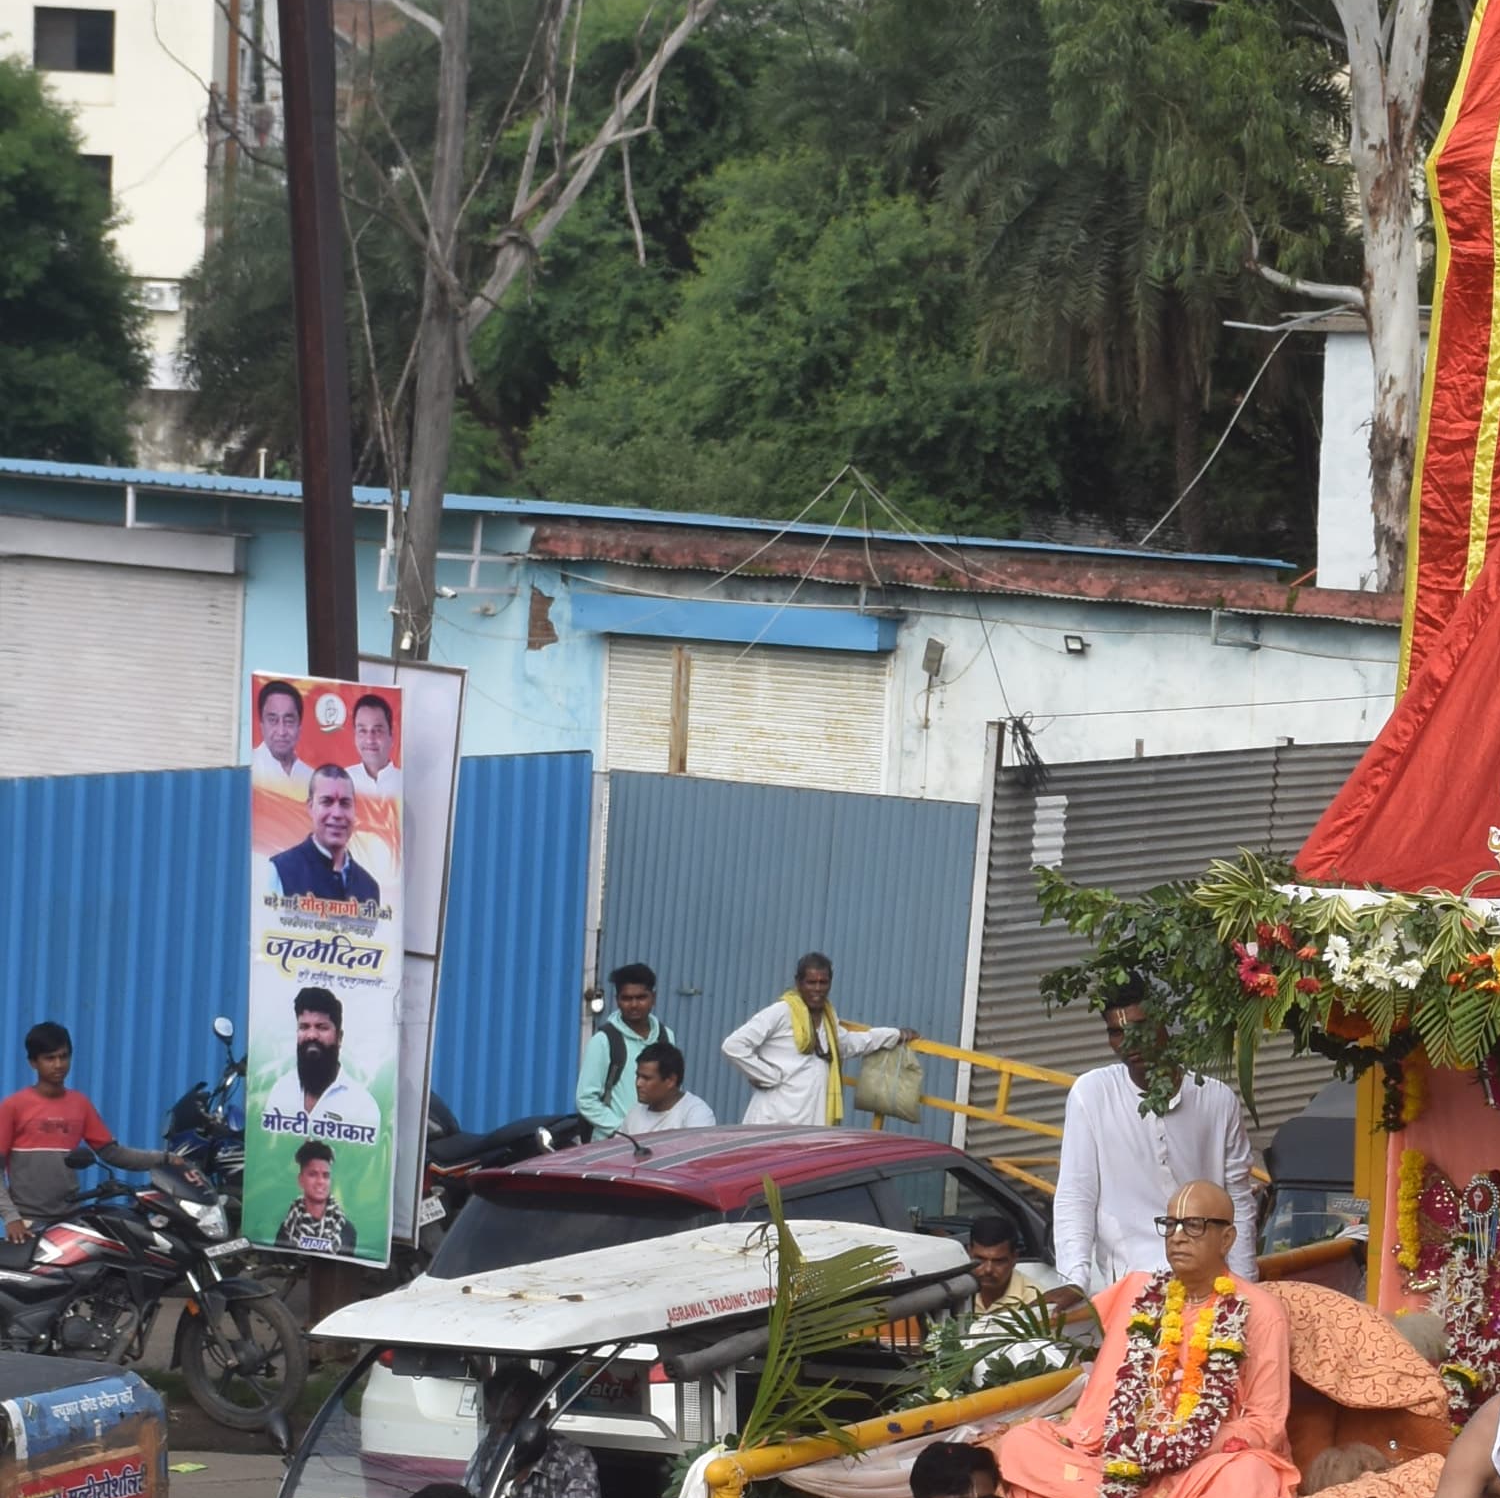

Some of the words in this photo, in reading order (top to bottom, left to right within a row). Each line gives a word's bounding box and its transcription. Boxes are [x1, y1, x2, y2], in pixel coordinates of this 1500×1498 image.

[266, 934, 384, 973] जन्मदिन
[263, 1107, 309, 1135] मोन्टी
[312, 1113, 377, 1144] वंशकार
[666, 1301, 710, 1321] AGRAWAL
[708, 1292, 748, 1313] TRADING
[747, 1286, 779, 1305] COMPA
